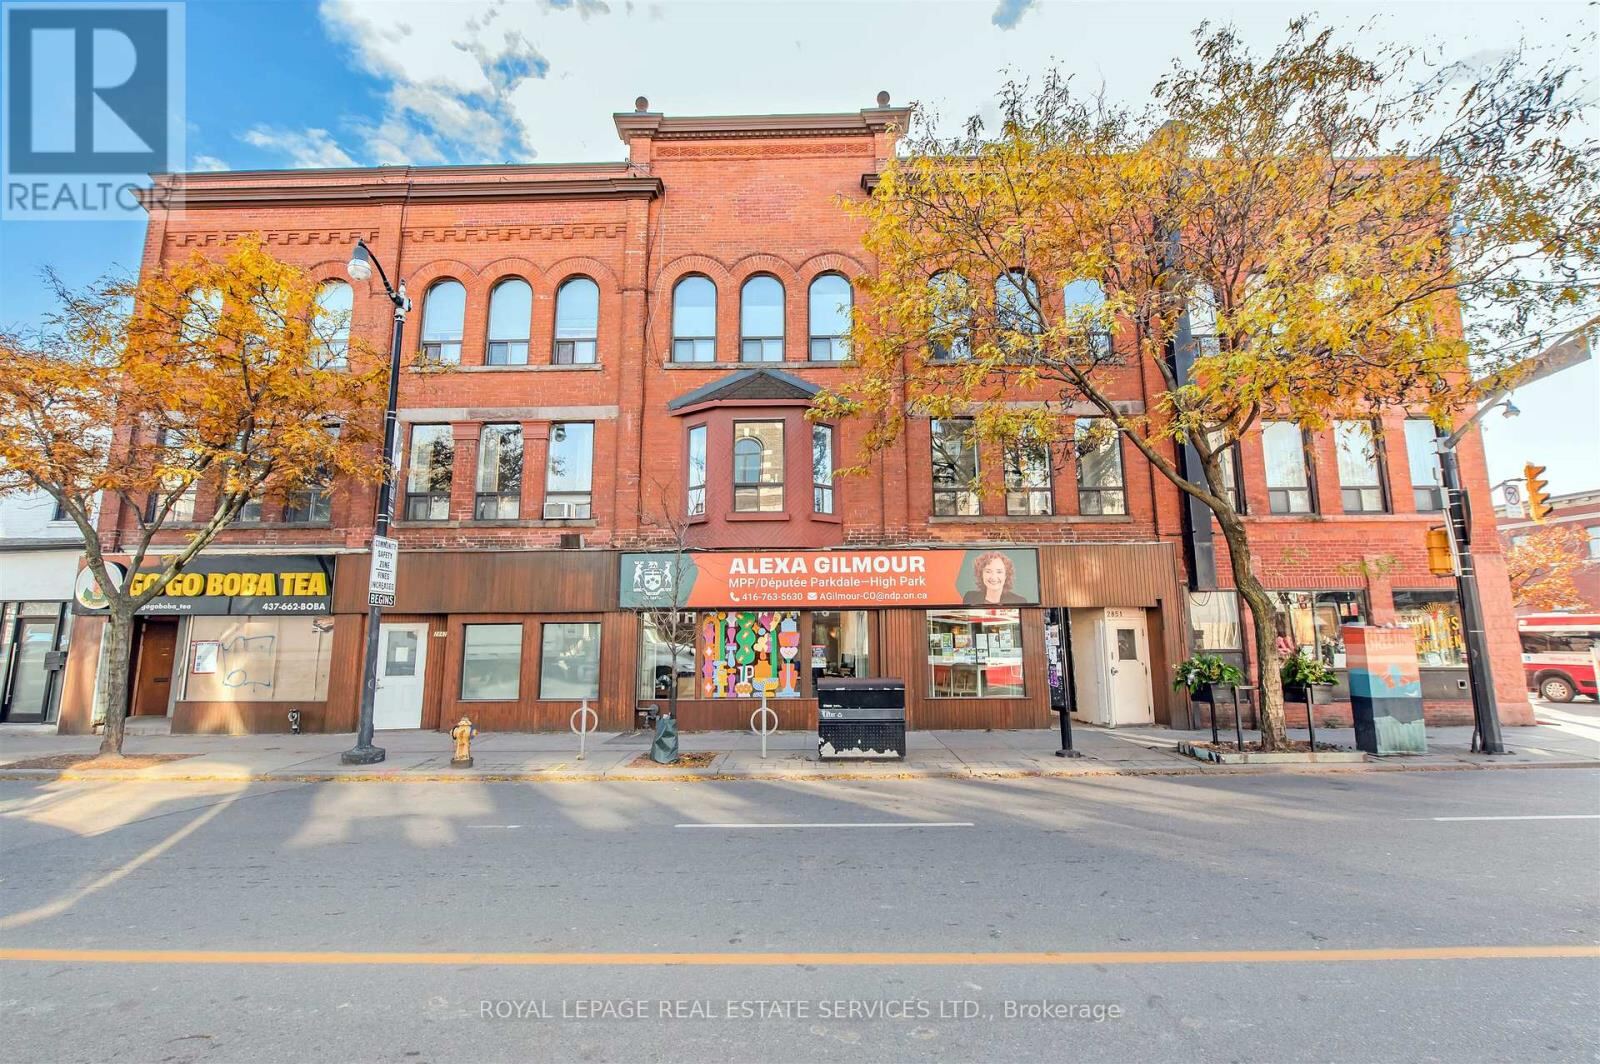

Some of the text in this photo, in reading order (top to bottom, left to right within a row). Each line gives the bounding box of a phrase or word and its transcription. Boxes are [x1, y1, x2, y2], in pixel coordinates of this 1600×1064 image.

[378, 550, 392, 559] SAFETY
[379, 560, 391, 570] ZONE
[729, 556, 926, 574] ALEXA GILMOUR
[377, 571, 390, 581] FINES
[165, 572, 205, 597] GO
[205, 572, 277, 596] BOBA
[279, 571, 328, 596] TEA
[729, 577, 807, 589] MPP/Députée
[899, 576, 926, 587] Park
[371, 594, 394, 605] BEGINS
[742, 592, 928, 601] 416-763-5630 AGilmour-CO@ndp.on.ca
[262, 602, 326, 611] 437-662-BOBA
[1401, 615, 1421, 624] EXIT
